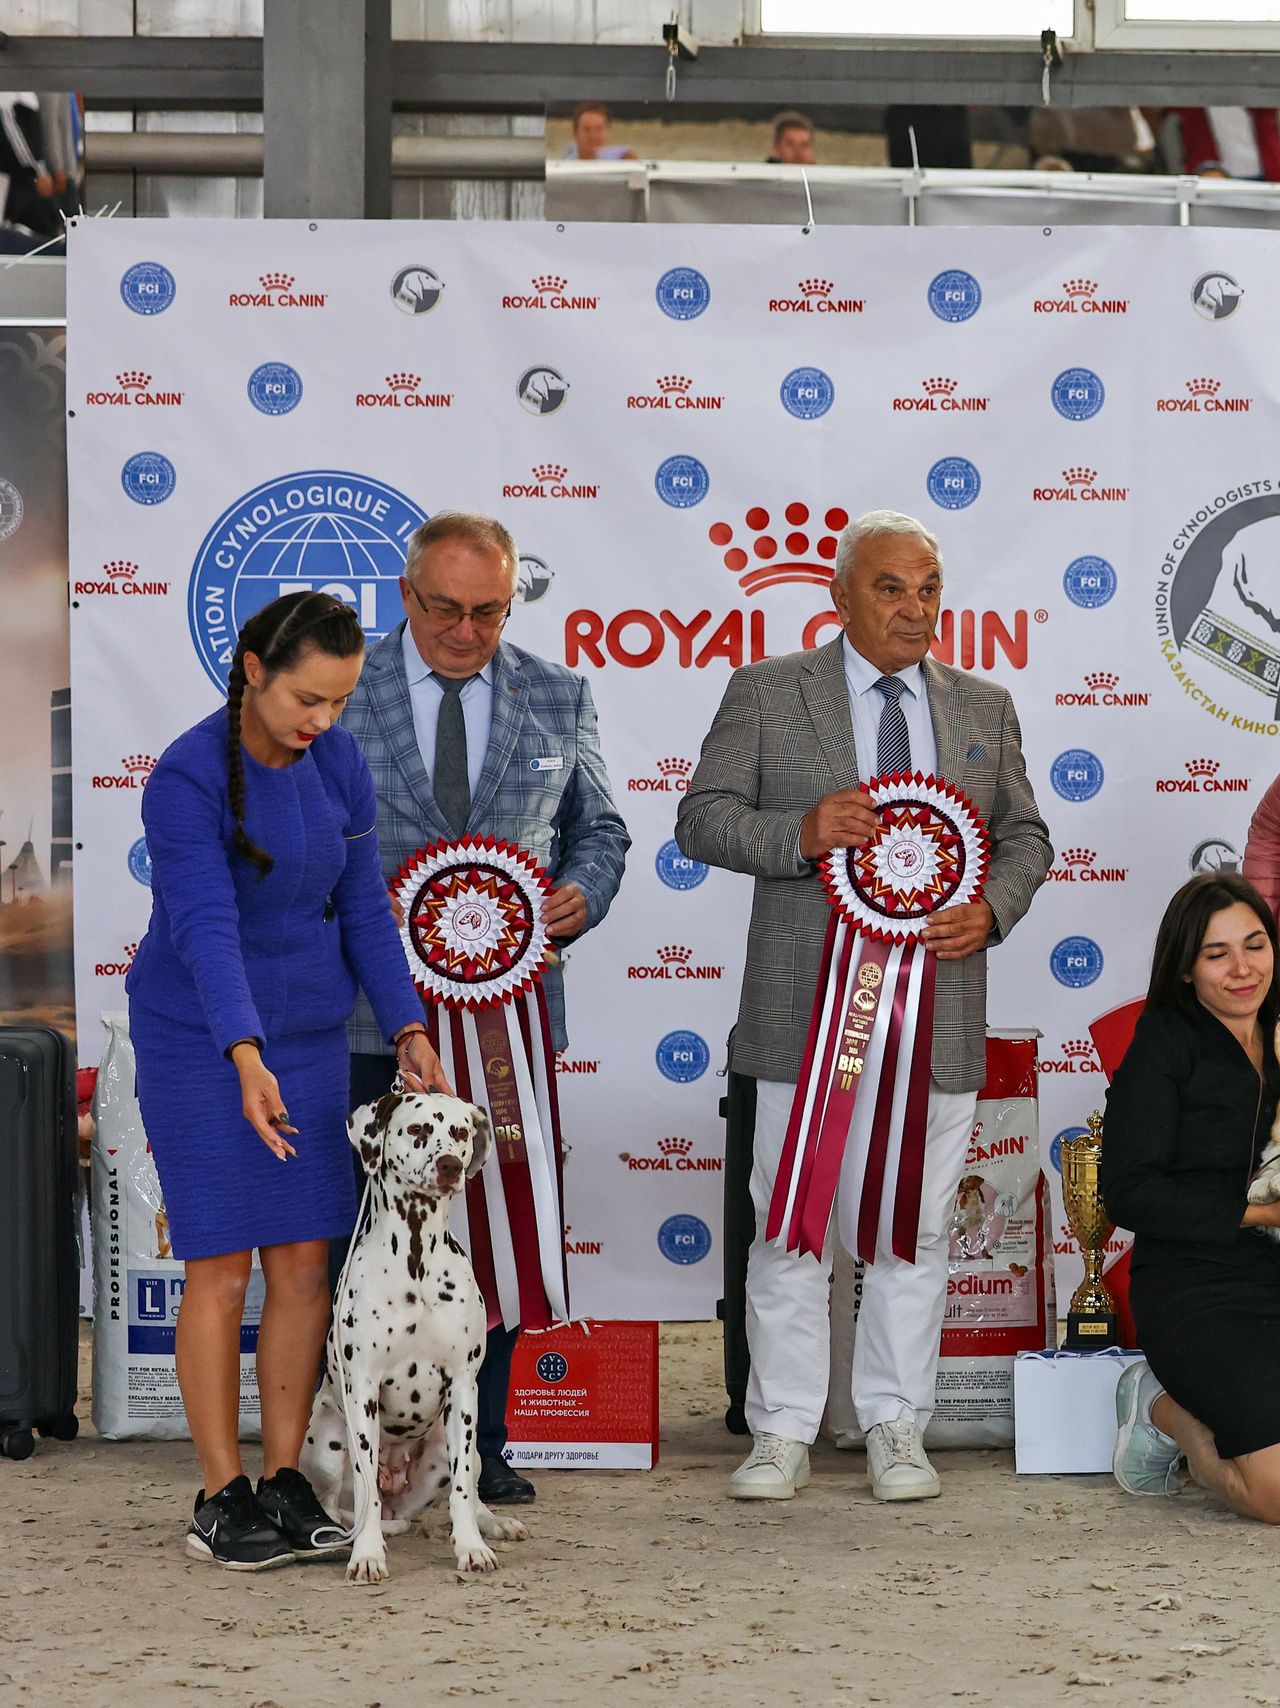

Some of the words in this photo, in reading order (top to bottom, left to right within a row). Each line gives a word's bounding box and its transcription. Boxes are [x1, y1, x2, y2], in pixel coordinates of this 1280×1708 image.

[138, 283, 159, 294] FCI
[229, 294, 273, 307] ROYAL
[769, 299, 813, 313] ROYAL
[1033, 300, 1078, 313] ROYAL
[265, 383, 286, 395] FCI
[1068, 389, 1089, 400] FCI
[86, 392, 131, 405] ROYAL
[356, 394, 401, 407] ROYAL
[892, 398, 937, 411] ROYAL
[139, 473, 160, 484] FCI
[502, 484, 546, 498] ROYAL
[1173, 479, 1272, 550] CYNOLOGISTS
[215, 486, 391, 569] CYNOLOGIQUE
[1161, 553, 1177, 575] OF
[74, 581, 118, 595] ROYAL
[1080, 576, 1101, 588] FCI
[1156, 582, 1169, 637] UNION
[565, 609, 772, 669] ROYAL
[1055, 693, 1099, 706] ROYAL
[1067, 770, 1088, 781] FCI
[1156, 779, 1199, 793] ROYAL
[673, 858, 694, 869] FCI
[627, 966, 671, 979] ROYAL
[673, 1052, 693, 1062] FCI
[838, 1054, 864, 1075] BIS
[840, 1074, 853, 1091] II
[495, 1124, 521, 1141] BIS
[628, 1158, 671, 1171] ROYAL
[108, 1167, 120, 1320] PROFESSIONAL
[673, 1233, 694, 1245] FCI
[946, 1275, 1013, 1295] edium
[145, 1287, 160, 1313] L
[943, 1304, 963, 1318] ult
[514, 1389, 556, 1397] ЗДОРОВЬЕ
[557, 1388, 587, 1397] ЛЮДЕЙ
[528, 1399, 576, 1407] ЖИВОТНЫХ
[540, 1409, 590, 1417] ПРОФЕССИЯ
[517, 1451, 543, 1460] ПОДАРИ
[544, 1452, 564, 1460] ДРУГУ
[565, 1451, 599, 1460] ЗДОРОВЬЕ
